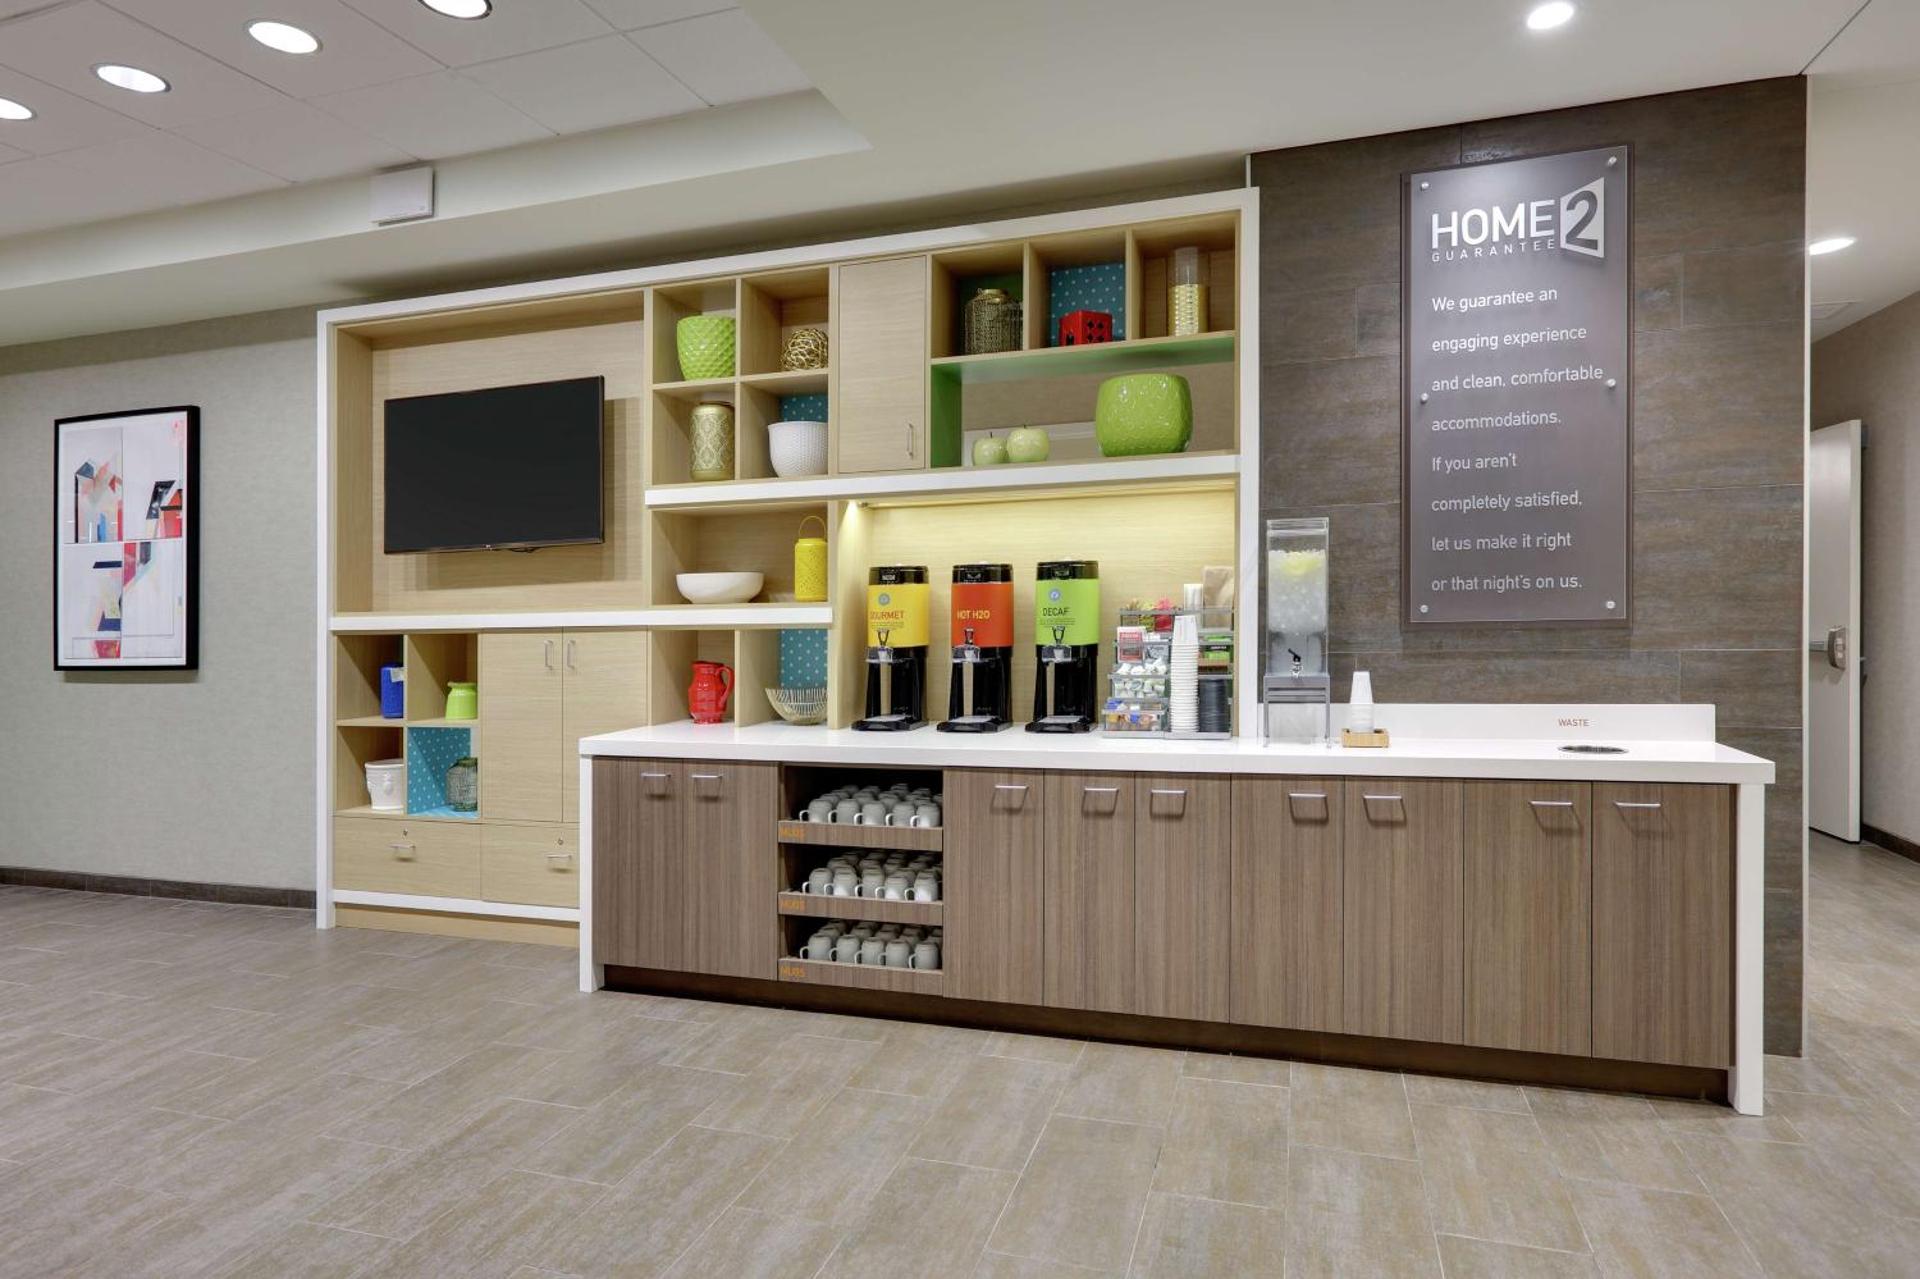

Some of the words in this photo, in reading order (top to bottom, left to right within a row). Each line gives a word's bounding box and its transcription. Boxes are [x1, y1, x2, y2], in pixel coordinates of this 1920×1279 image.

[1432, 239, 1555, 262] GUARANTEE
[1432, 296, 1455, 311] We
[1460, 289, 1534, 312] guarantee
[1539, 288, 1557, 301] an
[1432, 334, 1499, 354] engaging
[1504, 327, 1587, 347] experience
[1432, 376, 1458, 391] and
[1511, 365, 1603, 386] comfortable
[1432, 410, 1561, 431] accommodations.
[1432, 457, 1440, 471] If
[1446, 458, 1470, 473] you
[1475, 452, 1517, 468] aren't
[1432, 495, 1510, 514] completely
[1432, 537, 1449, 551] let
[1454, 538, 1471, 550] us
[1477, 534, 1517, 549] make
[1523, 533, 1531, 548] it
[1536, 532, 1572, 551] right
[1432, 578, 1447, 591] or
[1452, 576, 1478, 591] that
[1483, 575, 1531, 593] night's
[1536, 576, 1554, 588] on
[1560, 576, 1582, 588] us.
[1042, 607, 1070, 617] DECAF
[1558, 718, 1590, 727] WASTE
